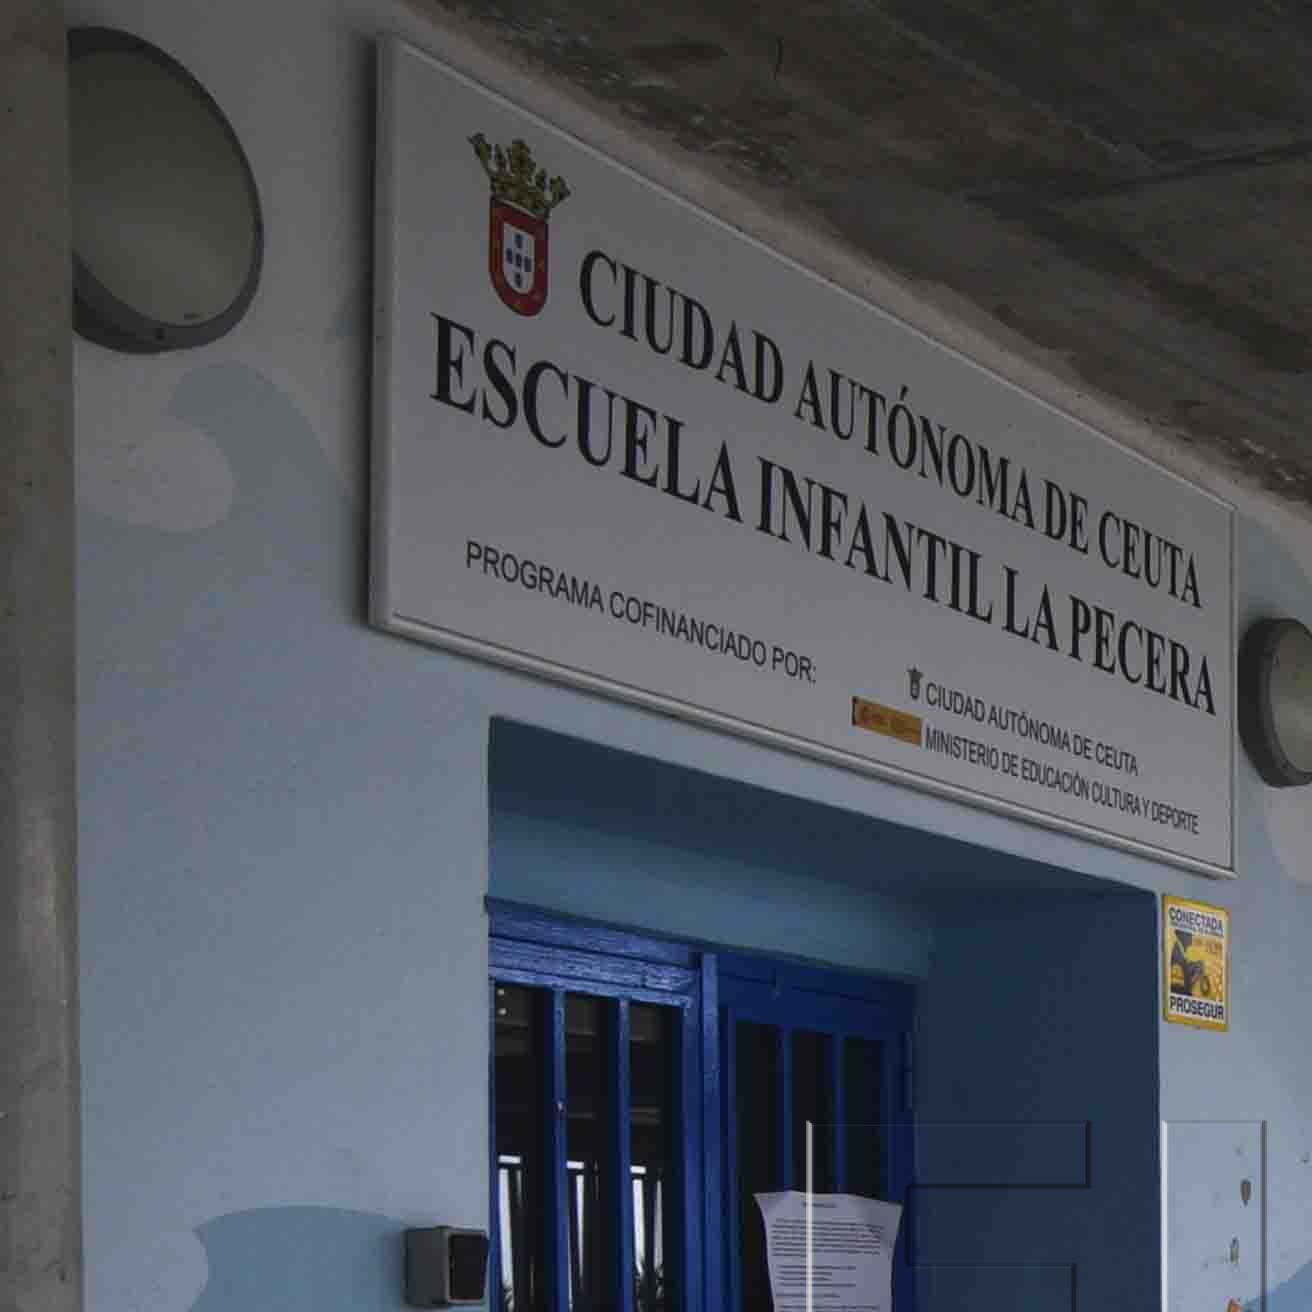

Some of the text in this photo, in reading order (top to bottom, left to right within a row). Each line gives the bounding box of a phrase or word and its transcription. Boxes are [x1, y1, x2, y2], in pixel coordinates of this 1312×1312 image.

[579, 249, 1203, 608] CIUDAD AUTÓNOMA DE CEUTA
[429, 311, 1216, 715] ESCUELA INFANTIL LA PECERA
[465, 540, 817, 684] PROGRAMA COFINANCIADO POR:
[925, 682, 1139, 777] CIUDAD AUTÓNOMA DE CEUTA
[925, 725, 1000, 771] MINISTERIO
[1001, 751, 1019, 777] DE
[1021, 756, 1090, 800] EDUCACIÓN
[1092, 780, 1141, 815] CULTURA
[1141, 793, 1150, 815] Y
[1150, 800, 1200, 836] DEPORTE
[1168, 906, 1224, 932] CONECTADA
[1169, 995, 1224, 1021] PROSEGUR
